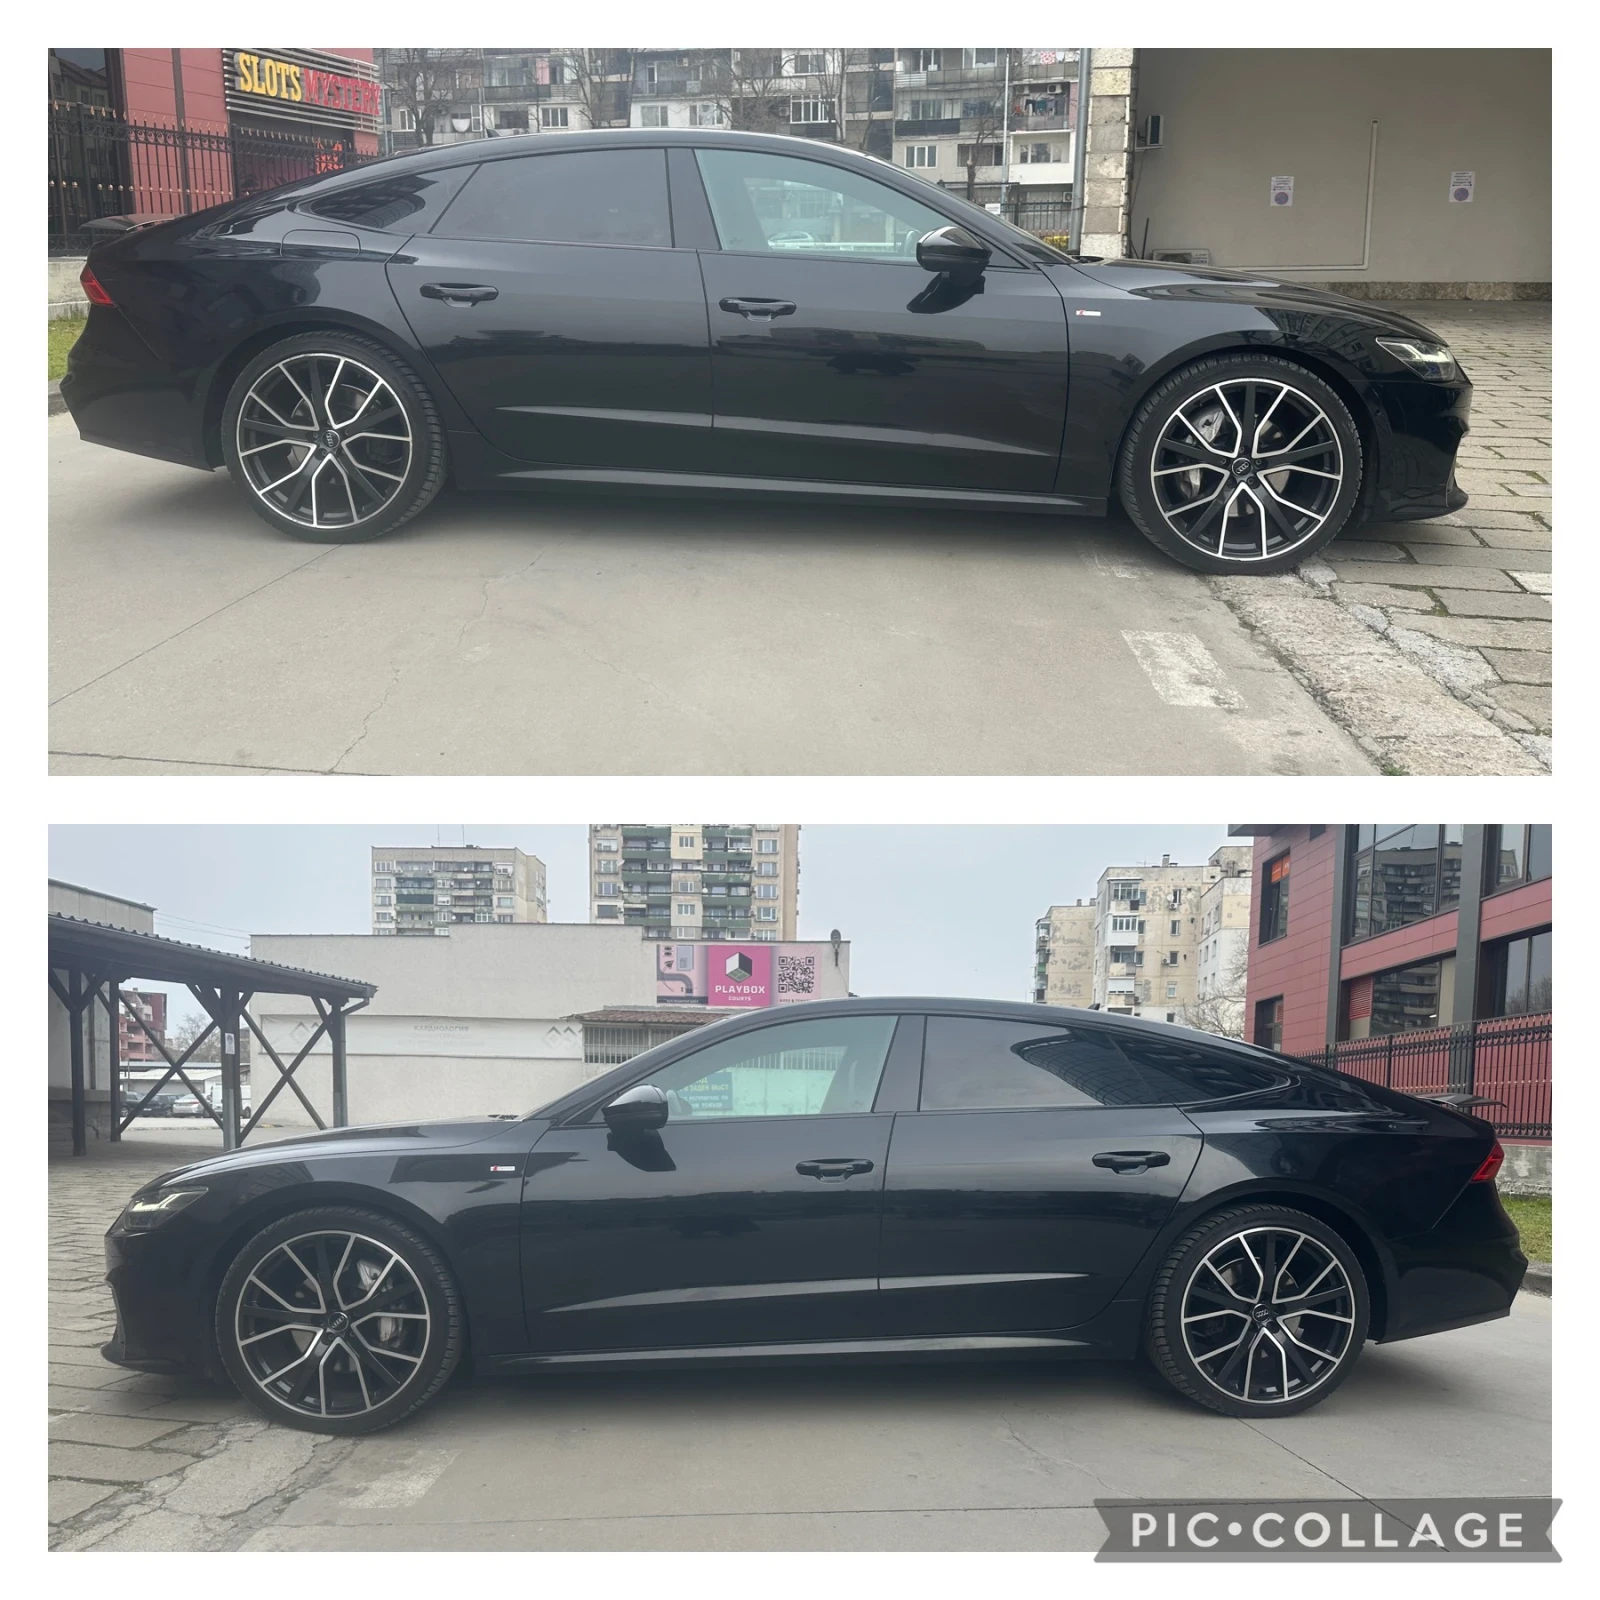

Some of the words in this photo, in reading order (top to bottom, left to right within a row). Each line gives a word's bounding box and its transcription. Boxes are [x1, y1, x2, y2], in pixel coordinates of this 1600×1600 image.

[235, 52, 301, 102] SLOTS
[303, 68, 380, 115] MYSTERY
[715, 985, 765, 994] PLAYBOX
